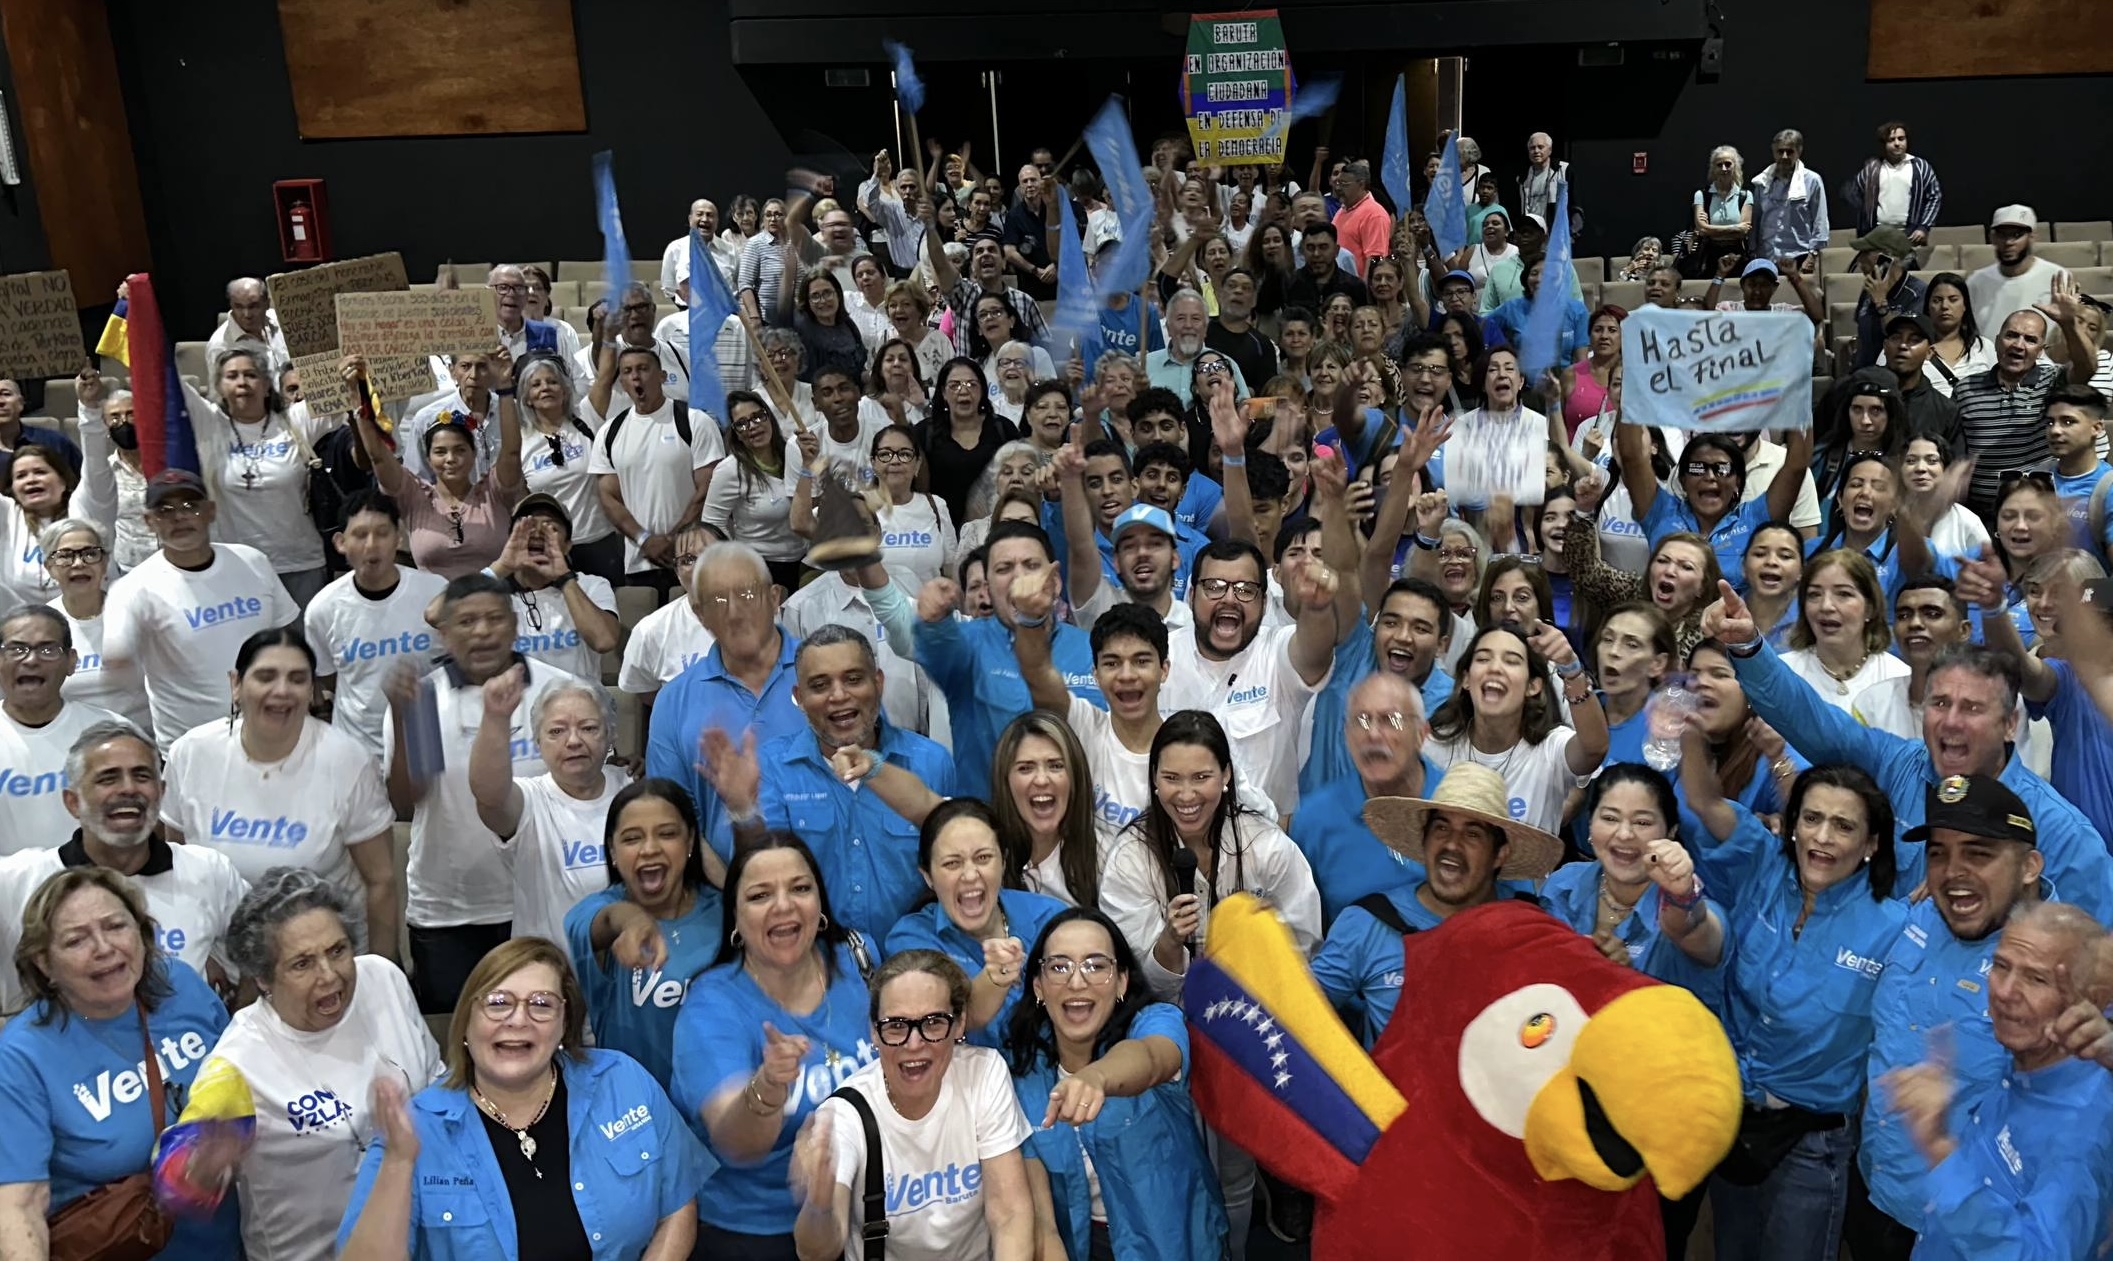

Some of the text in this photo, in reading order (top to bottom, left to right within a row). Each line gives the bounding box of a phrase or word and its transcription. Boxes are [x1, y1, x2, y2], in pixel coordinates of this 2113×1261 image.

[1214, 25, 1256, 42] BARUTA
[1189, 56, 1201, 72] EN
[1208, 82, 1266, 101] CIUDADANA
[1199, 112, 1210, 129] EN
[1218, 111, 1263, 128] DEFENSA
[1199, 137, 1281, 157] LA DEMOCRACIA
[42, 275, 66, 293] NO
[1641, 315, 1741, 364] Hasta
[183, 597, 262, 628] Vente
[342, 631, 431, 663] Vente
[514, 629, 582, 653] ente
[1227, 685, 1267, 704] Vente
[212, 806, 308, 843] Vente
[1836, 945, 1883, 975] Vente
[73, 1032, 206, 1122] Vente
[288, 1090, 334, 1115] CON
[288, 1100, 352, 1131] VZLA
[600, 1105, 648, 1140] Vente
[424, 1175, 449, 1186] Lilian
[886, 1163, 982, 1212] Vente
[945, 1190, 978, 1205] Baruta
